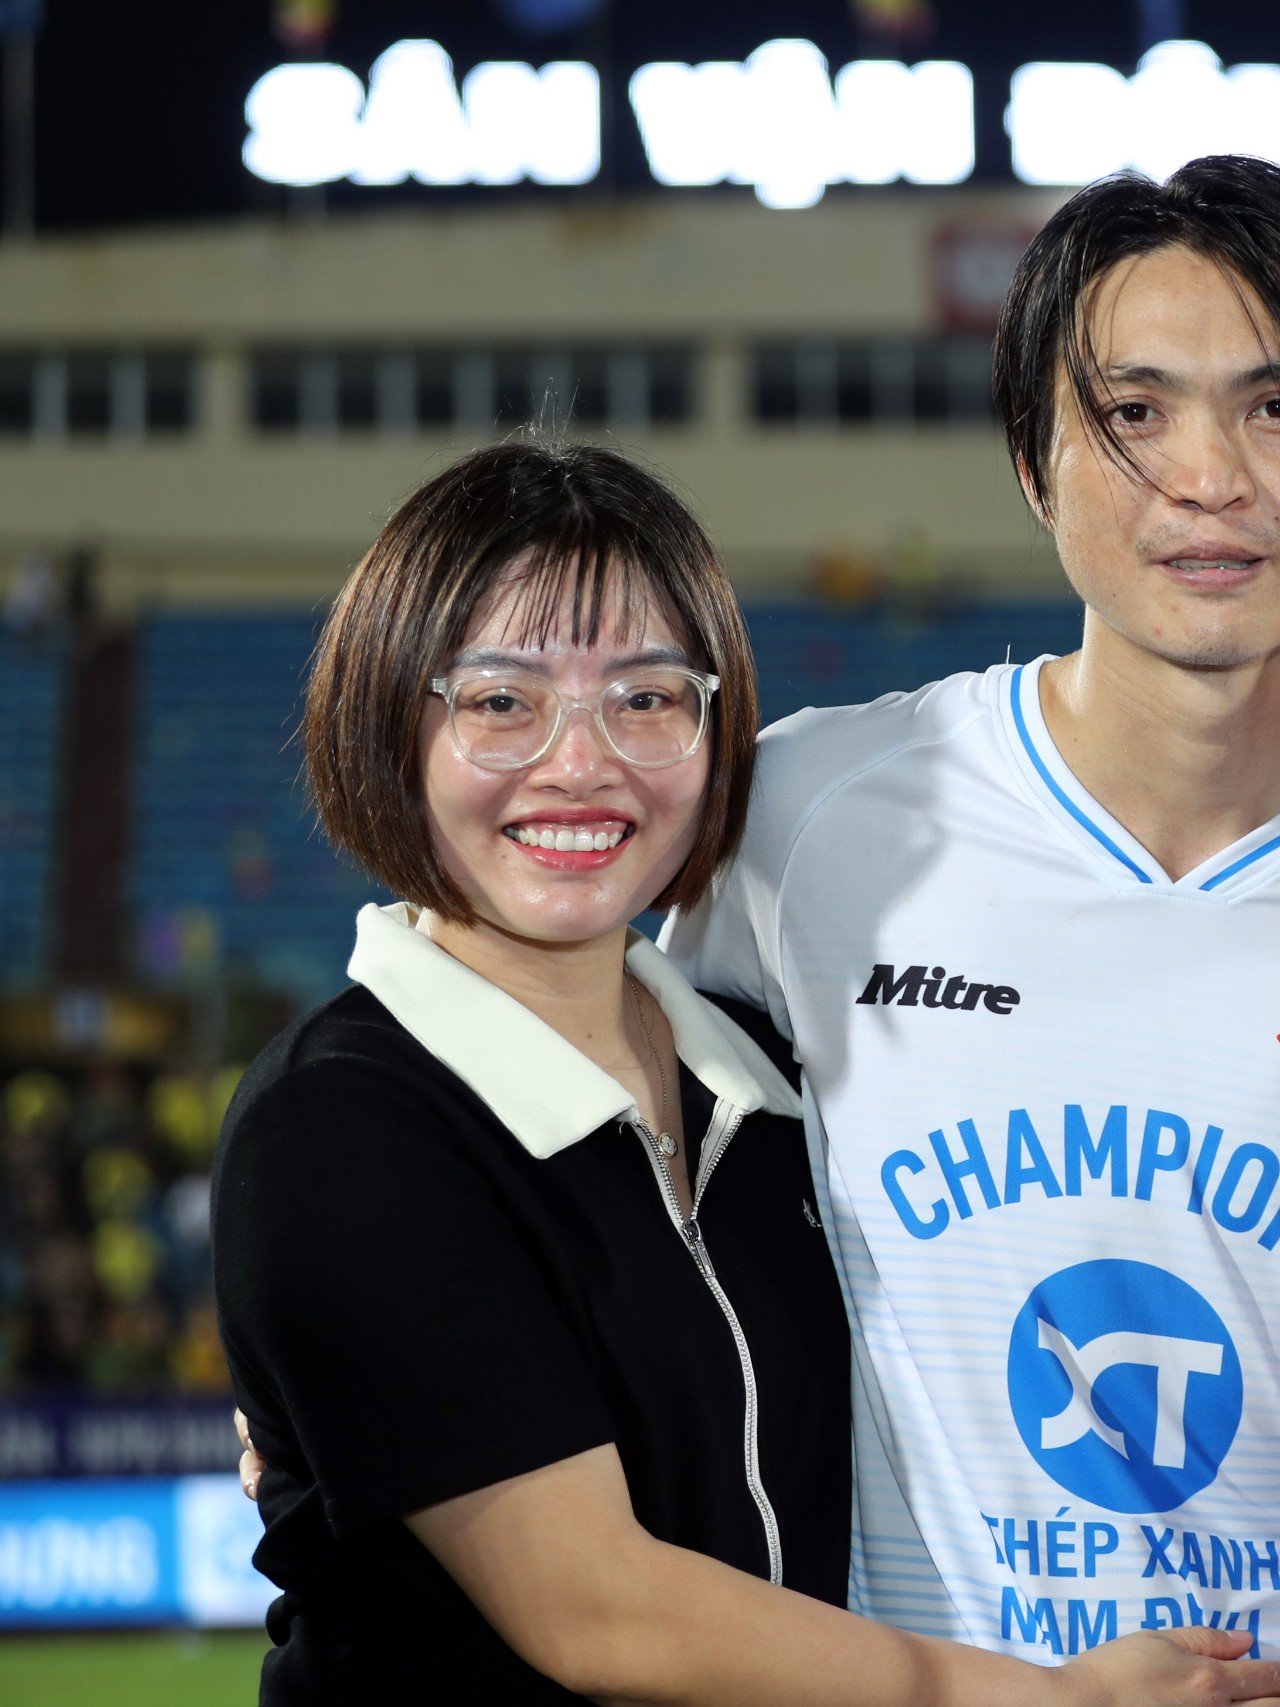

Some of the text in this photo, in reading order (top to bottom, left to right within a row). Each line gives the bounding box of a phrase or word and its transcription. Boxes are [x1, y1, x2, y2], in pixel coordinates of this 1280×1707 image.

[242, 38, 600, 186] SÂN
[629, 38, 975, 209] VẬN
[856, 964, 1021, 1016] Mitre
[1001, 1586, 1118, 1656] NAM
